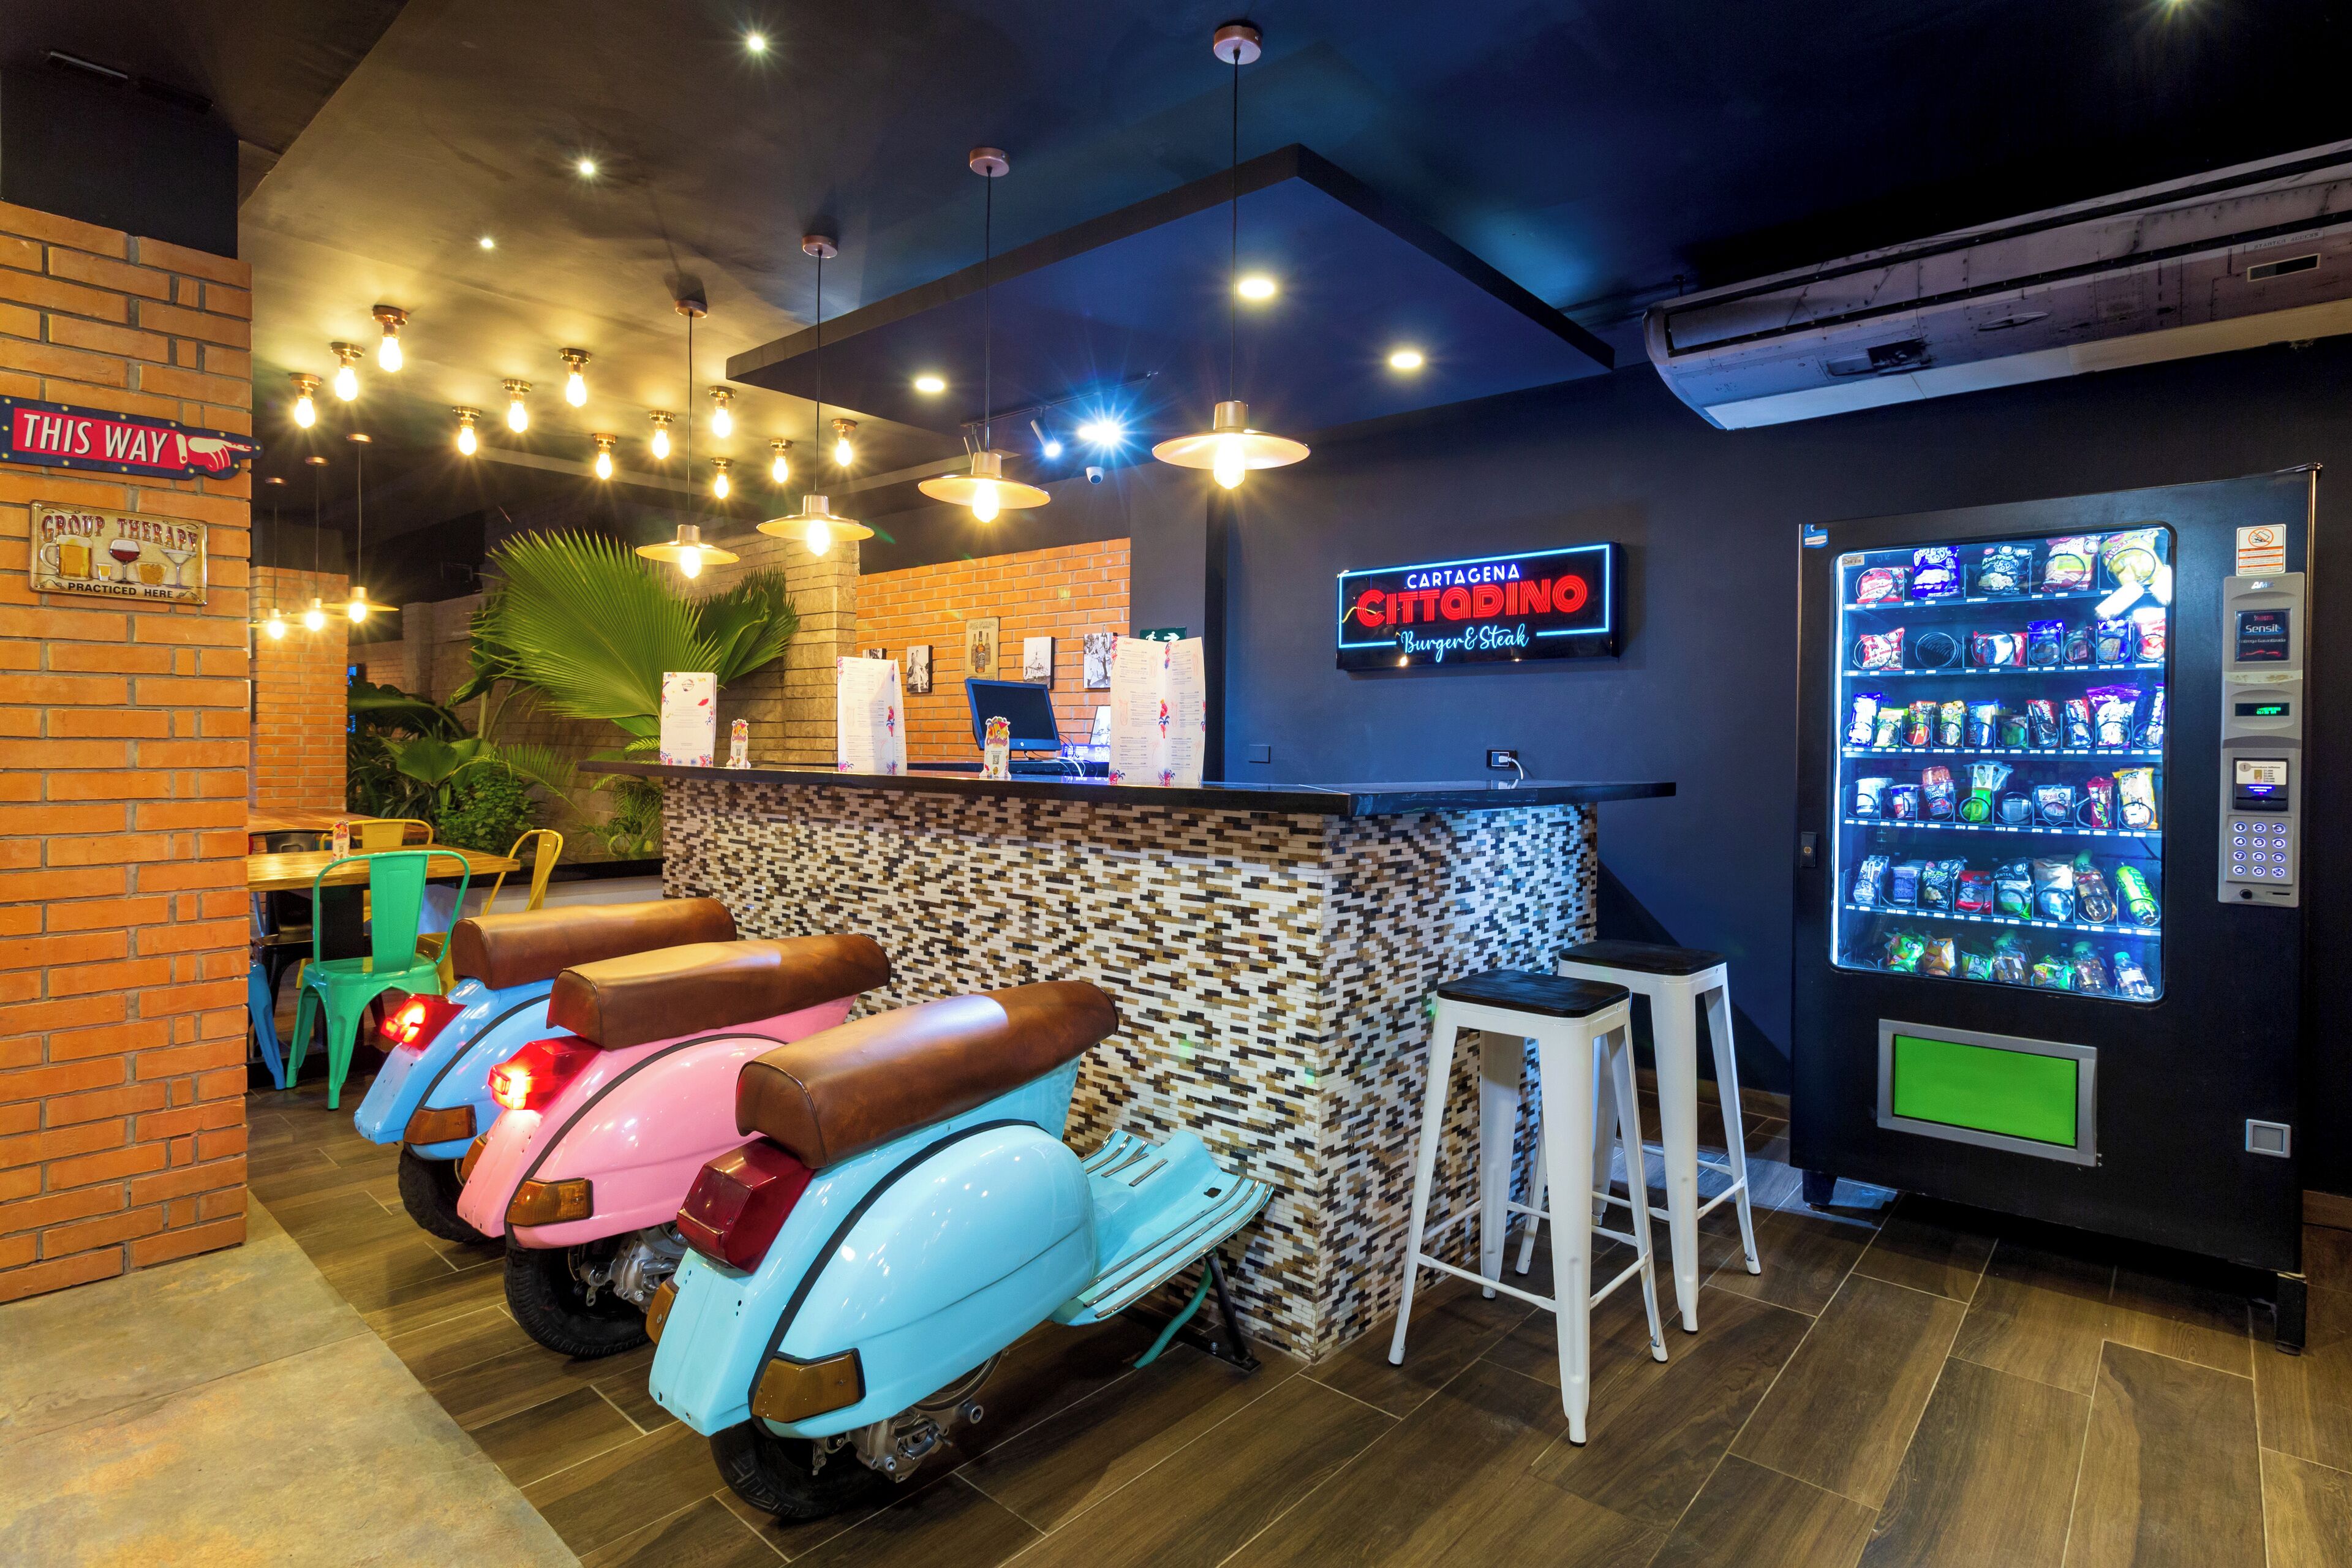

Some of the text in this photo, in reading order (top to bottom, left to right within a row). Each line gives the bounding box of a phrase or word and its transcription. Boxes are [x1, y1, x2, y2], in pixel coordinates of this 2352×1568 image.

[23, 413, 168, 463] THIS WAY
[41, 515, 198, 551] GROUP THERAPY
[68, 582, 174, 599] PRACTICED HERE
[1406, 563, 1520, 589] CARTAGENA
[1356, 575, 1588, 628] CITTADINO
[2245, 624, 2279, 633] Sensit
